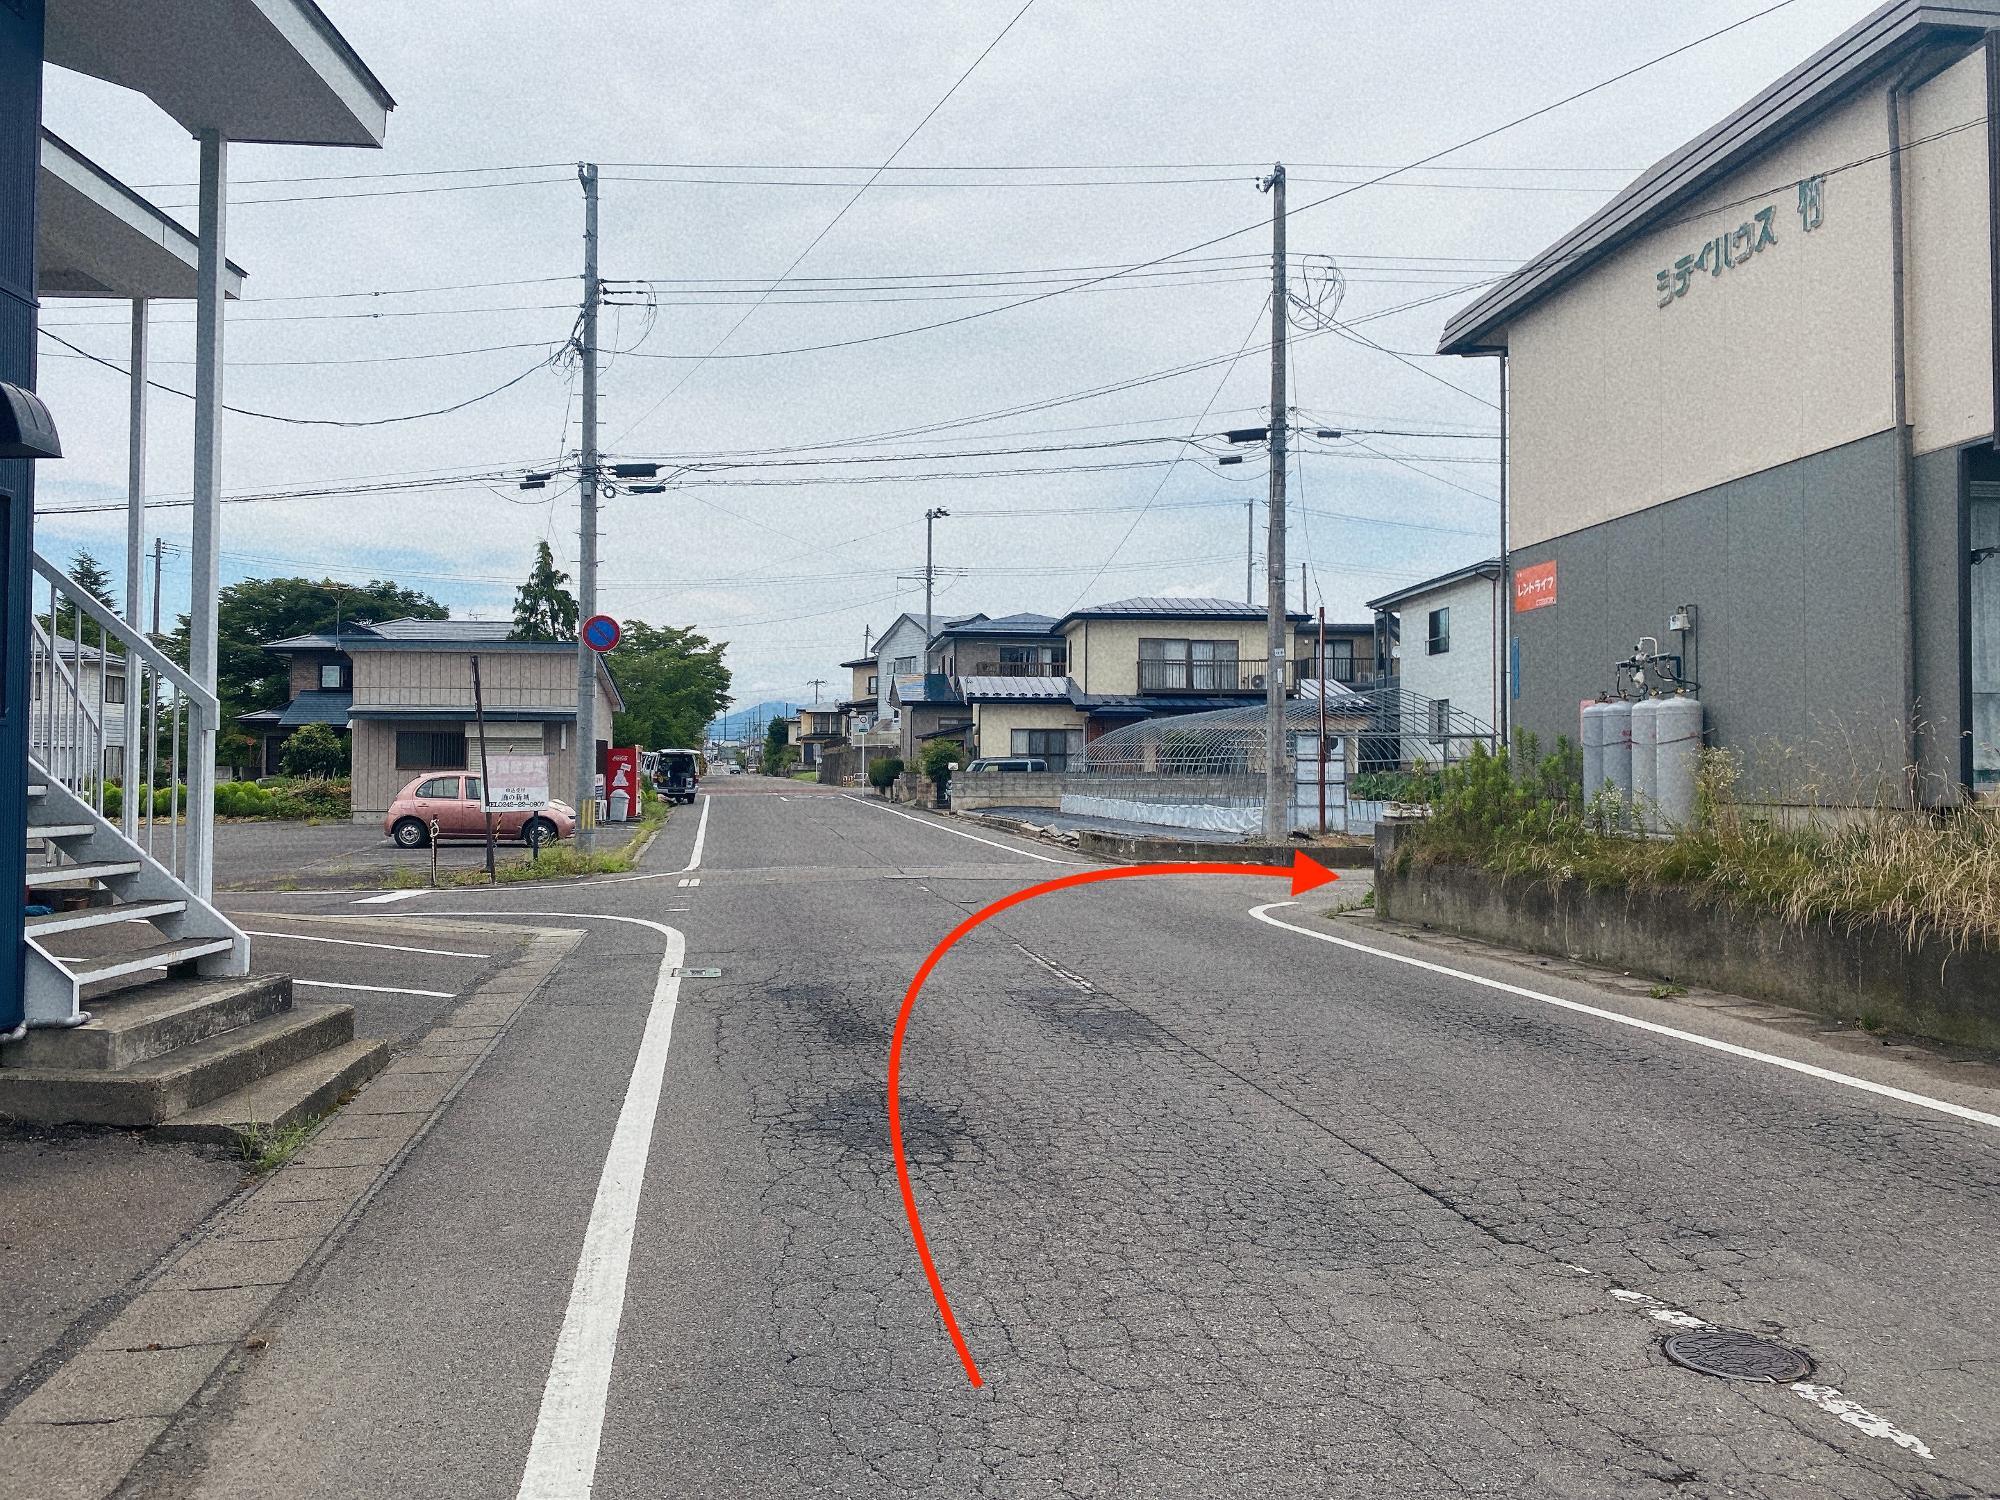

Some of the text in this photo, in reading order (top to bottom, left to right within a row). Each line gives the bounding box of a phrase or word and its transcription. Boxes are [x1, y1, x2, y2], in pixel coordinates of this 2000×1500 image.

[1517, 575, 1554, 597] レントライフ
